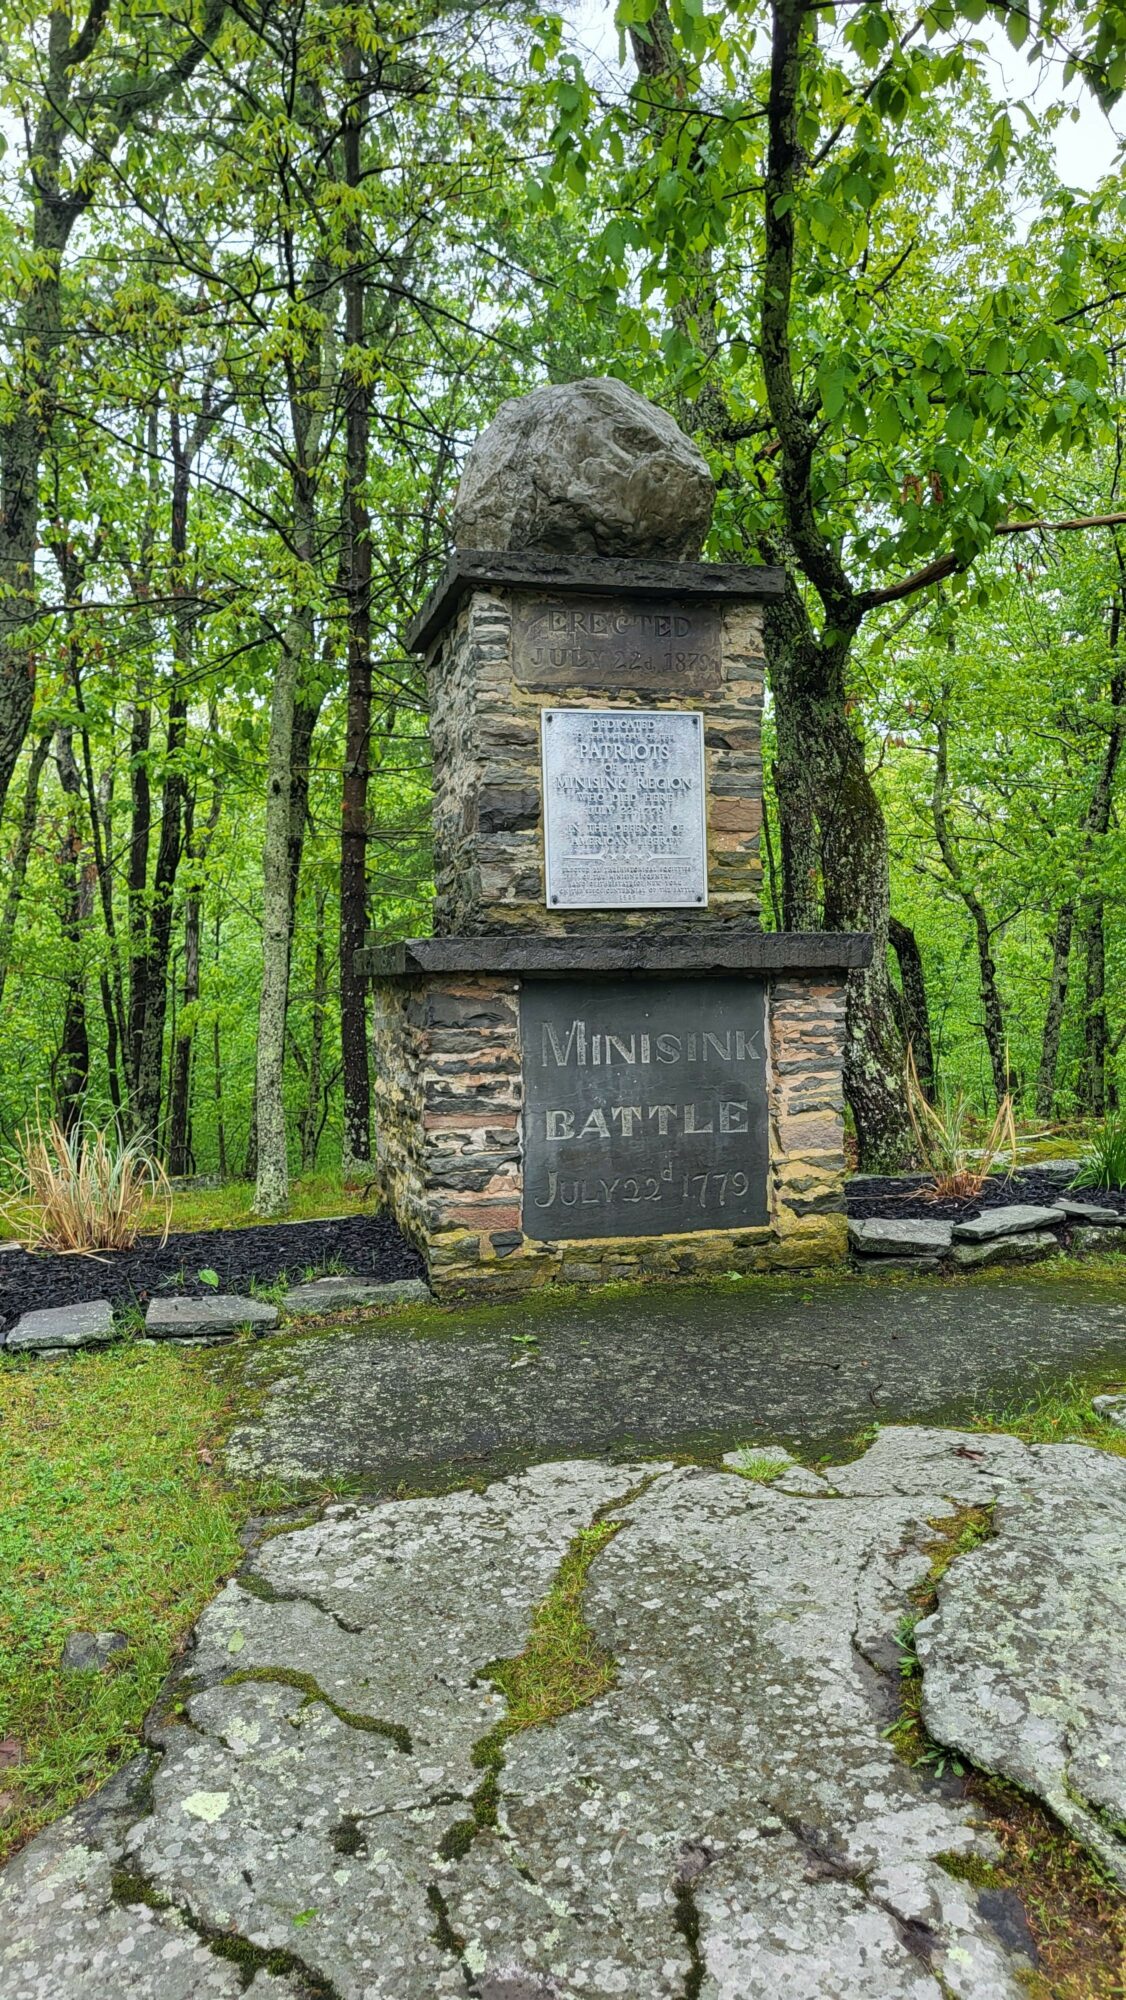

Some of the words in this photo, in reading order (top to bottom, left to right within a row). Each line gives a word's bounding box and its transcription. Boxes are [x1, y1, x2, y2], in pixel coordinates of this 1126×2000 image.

[550, 610, 692, 638] ERECTED
[529, 648, 602, 669] JULY
[592, 719, 655, 729] DEDICATED
[579, 744, 670, 760] PATRIOTS
[604, 763, 617, 773] OF
[624, 763, 645, 773] THE
[555, 776, 627, 790] MINISINK
[637, 777, 693, 790] REGION
[577, 792, 604, 801] WHO
[613, 792, 637, 801] DIED
[643, 793, 673, 801] HERE
[589, 805, 614, 815] JULY
[568, 824, 580, 833] IN
[588, 824, 608, 833] THE
[670, 824, 685, 833] OF
[571, 836, 630, 846] AMERICAN
[638, 836, 682, 846] LIBERTY
[545, 1101, 749, 1141] BATTLE
[534, 1171, 621, 1208] JULY
[682, 1172, 749, 1208] 1779
